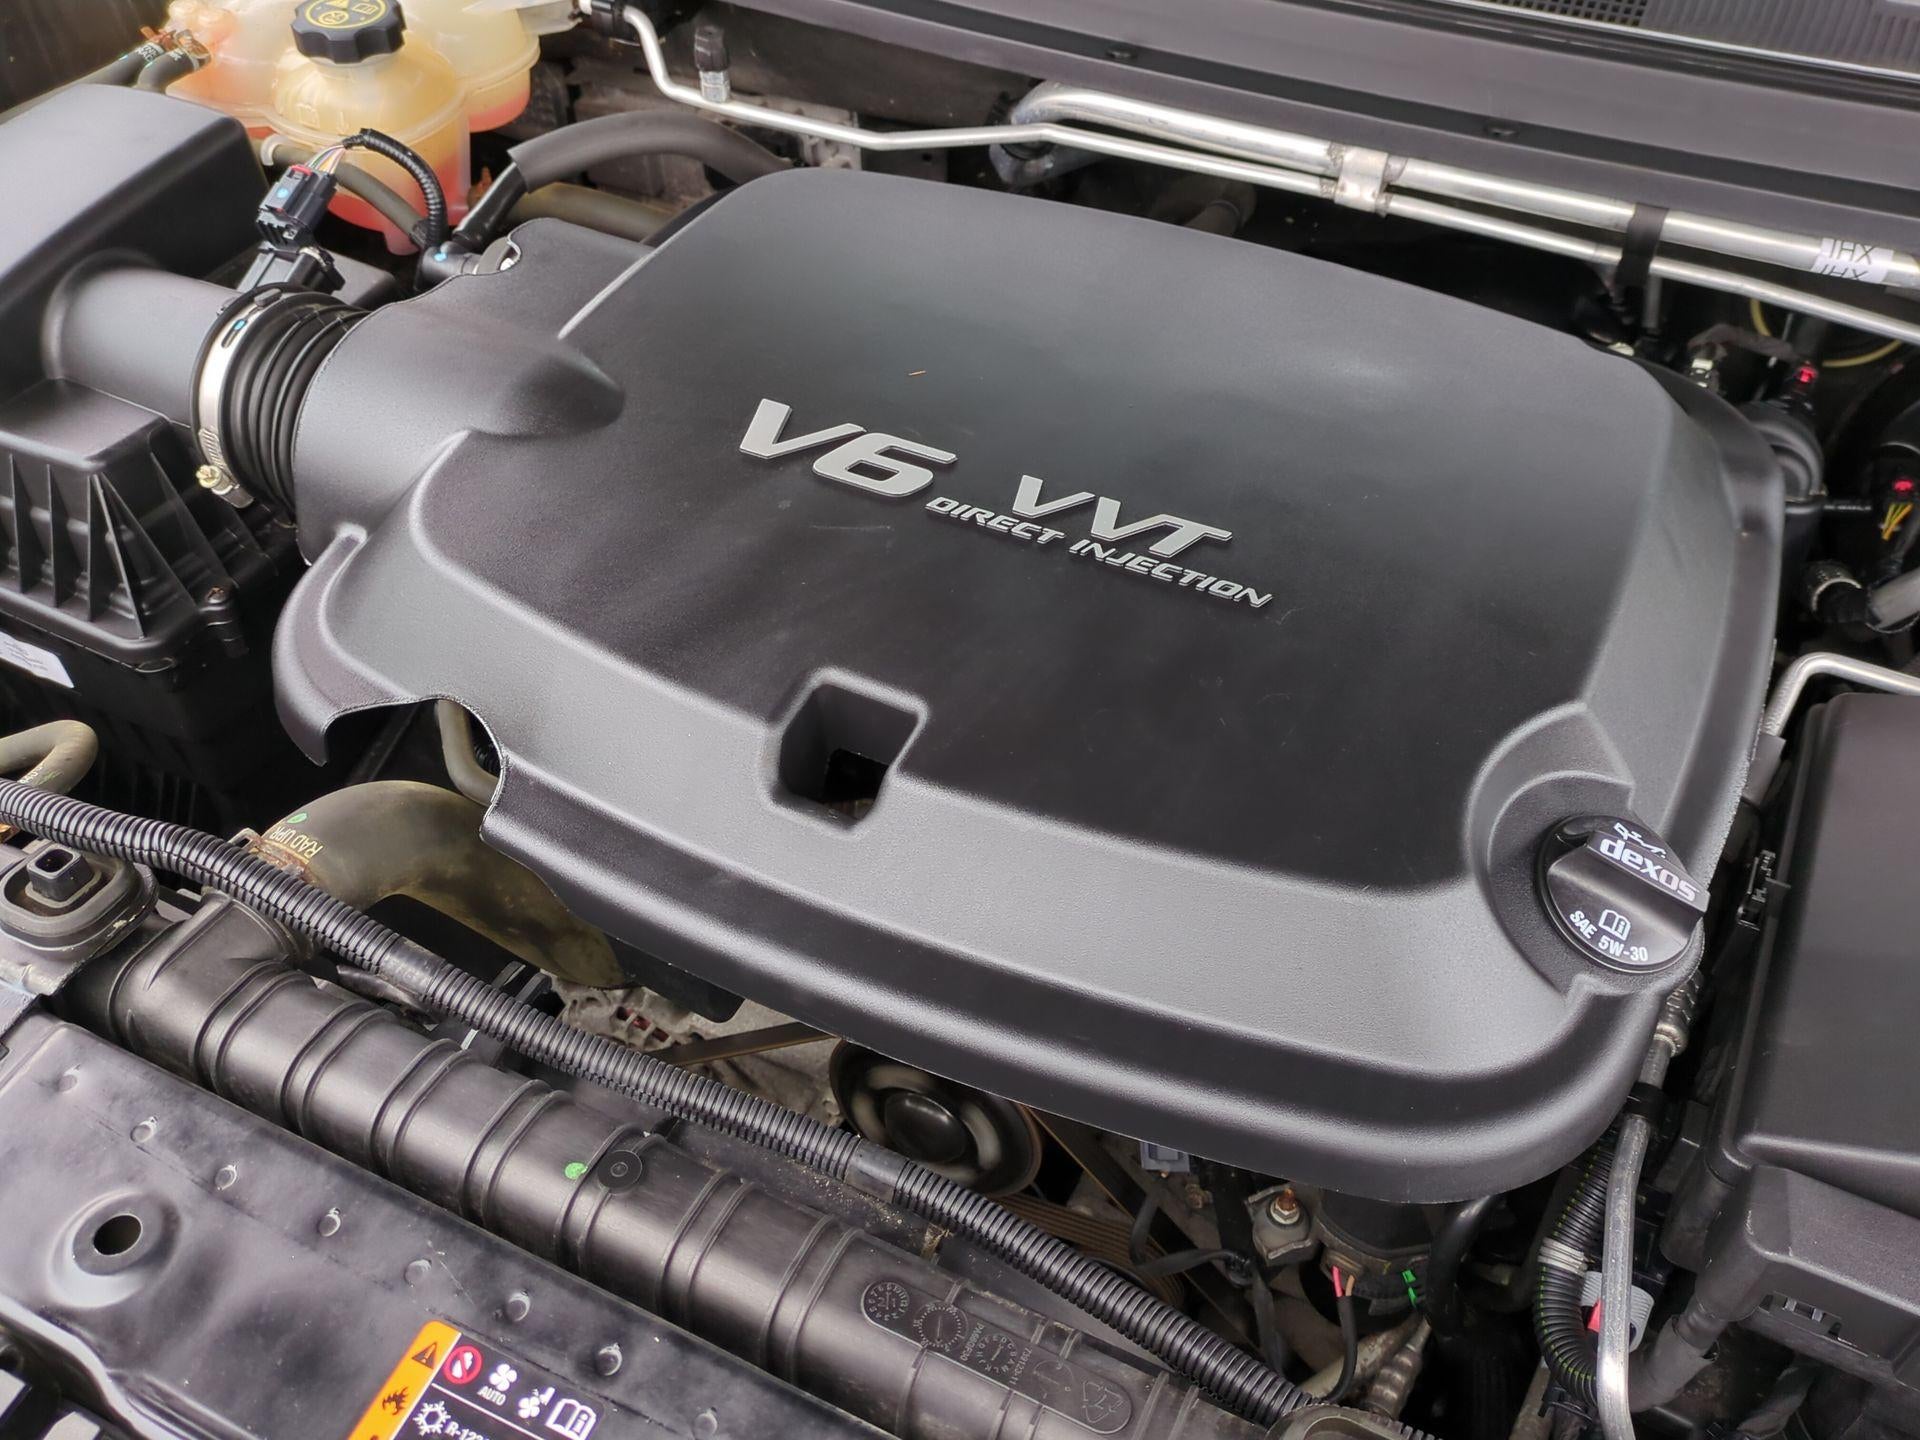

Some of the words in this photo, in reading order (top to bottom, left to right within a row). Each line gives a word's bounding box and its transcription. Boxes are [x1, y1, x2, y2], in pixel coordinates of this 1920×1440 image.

[739, 398, 957, 498] V6
[1012, 475, 1233, 557] VVT
[925, 496, 1066, 544] DIRECT
[1069, 538, 1273, 608] INJECTION
[289, 834, 324, 859] RAD
[1600, 838, 1700, 902] dexos
[1569, 910, 1598, 939] SAE
[1598, 935, 1649, 962] 5W-30
[477, 1386, 506, 1406] AUTO
[445, 1421, 489, 1440] R-12
